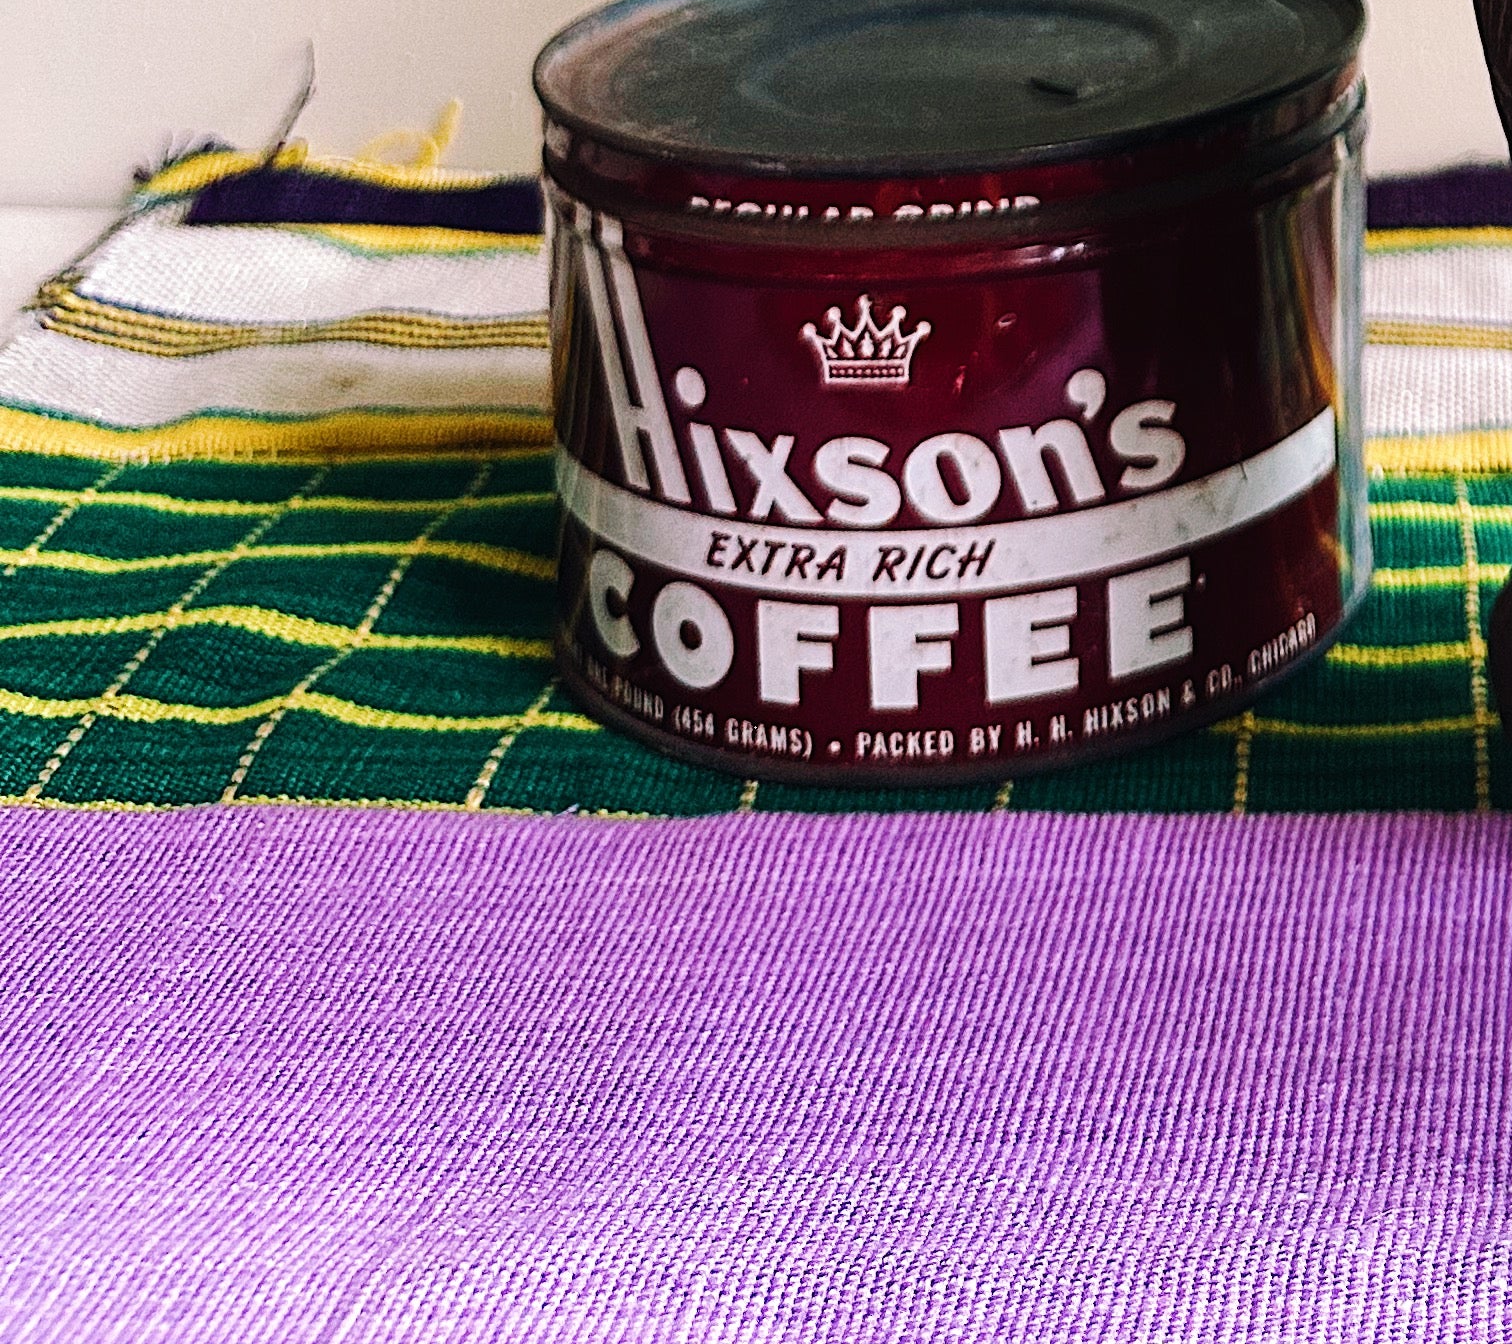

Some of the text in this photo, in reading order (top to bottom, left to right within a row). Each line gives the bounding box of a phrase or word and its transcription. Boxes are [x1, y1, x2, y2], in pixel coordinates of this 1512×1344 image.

[575, 198, 1187, 528] Hixson's
[589, 547, 1195, 712] COFFEE
[705, 529, 998, 583] EXTRA RICH
[673, 703, 715, 738] (454
[724, 716, 813, 761] GRAMS)
[855, 729, 955, 760] PACKED
[969, 724, 1002, 756] BY
[1015, 719, 1040, 752] H.
[1049, 713, 1074, 744] H.
[1082, 686, 1171, 738] HIXSON
[1179, 677, 1197, 708] &
[1247, 611, 1317, 677] CHICAGO
